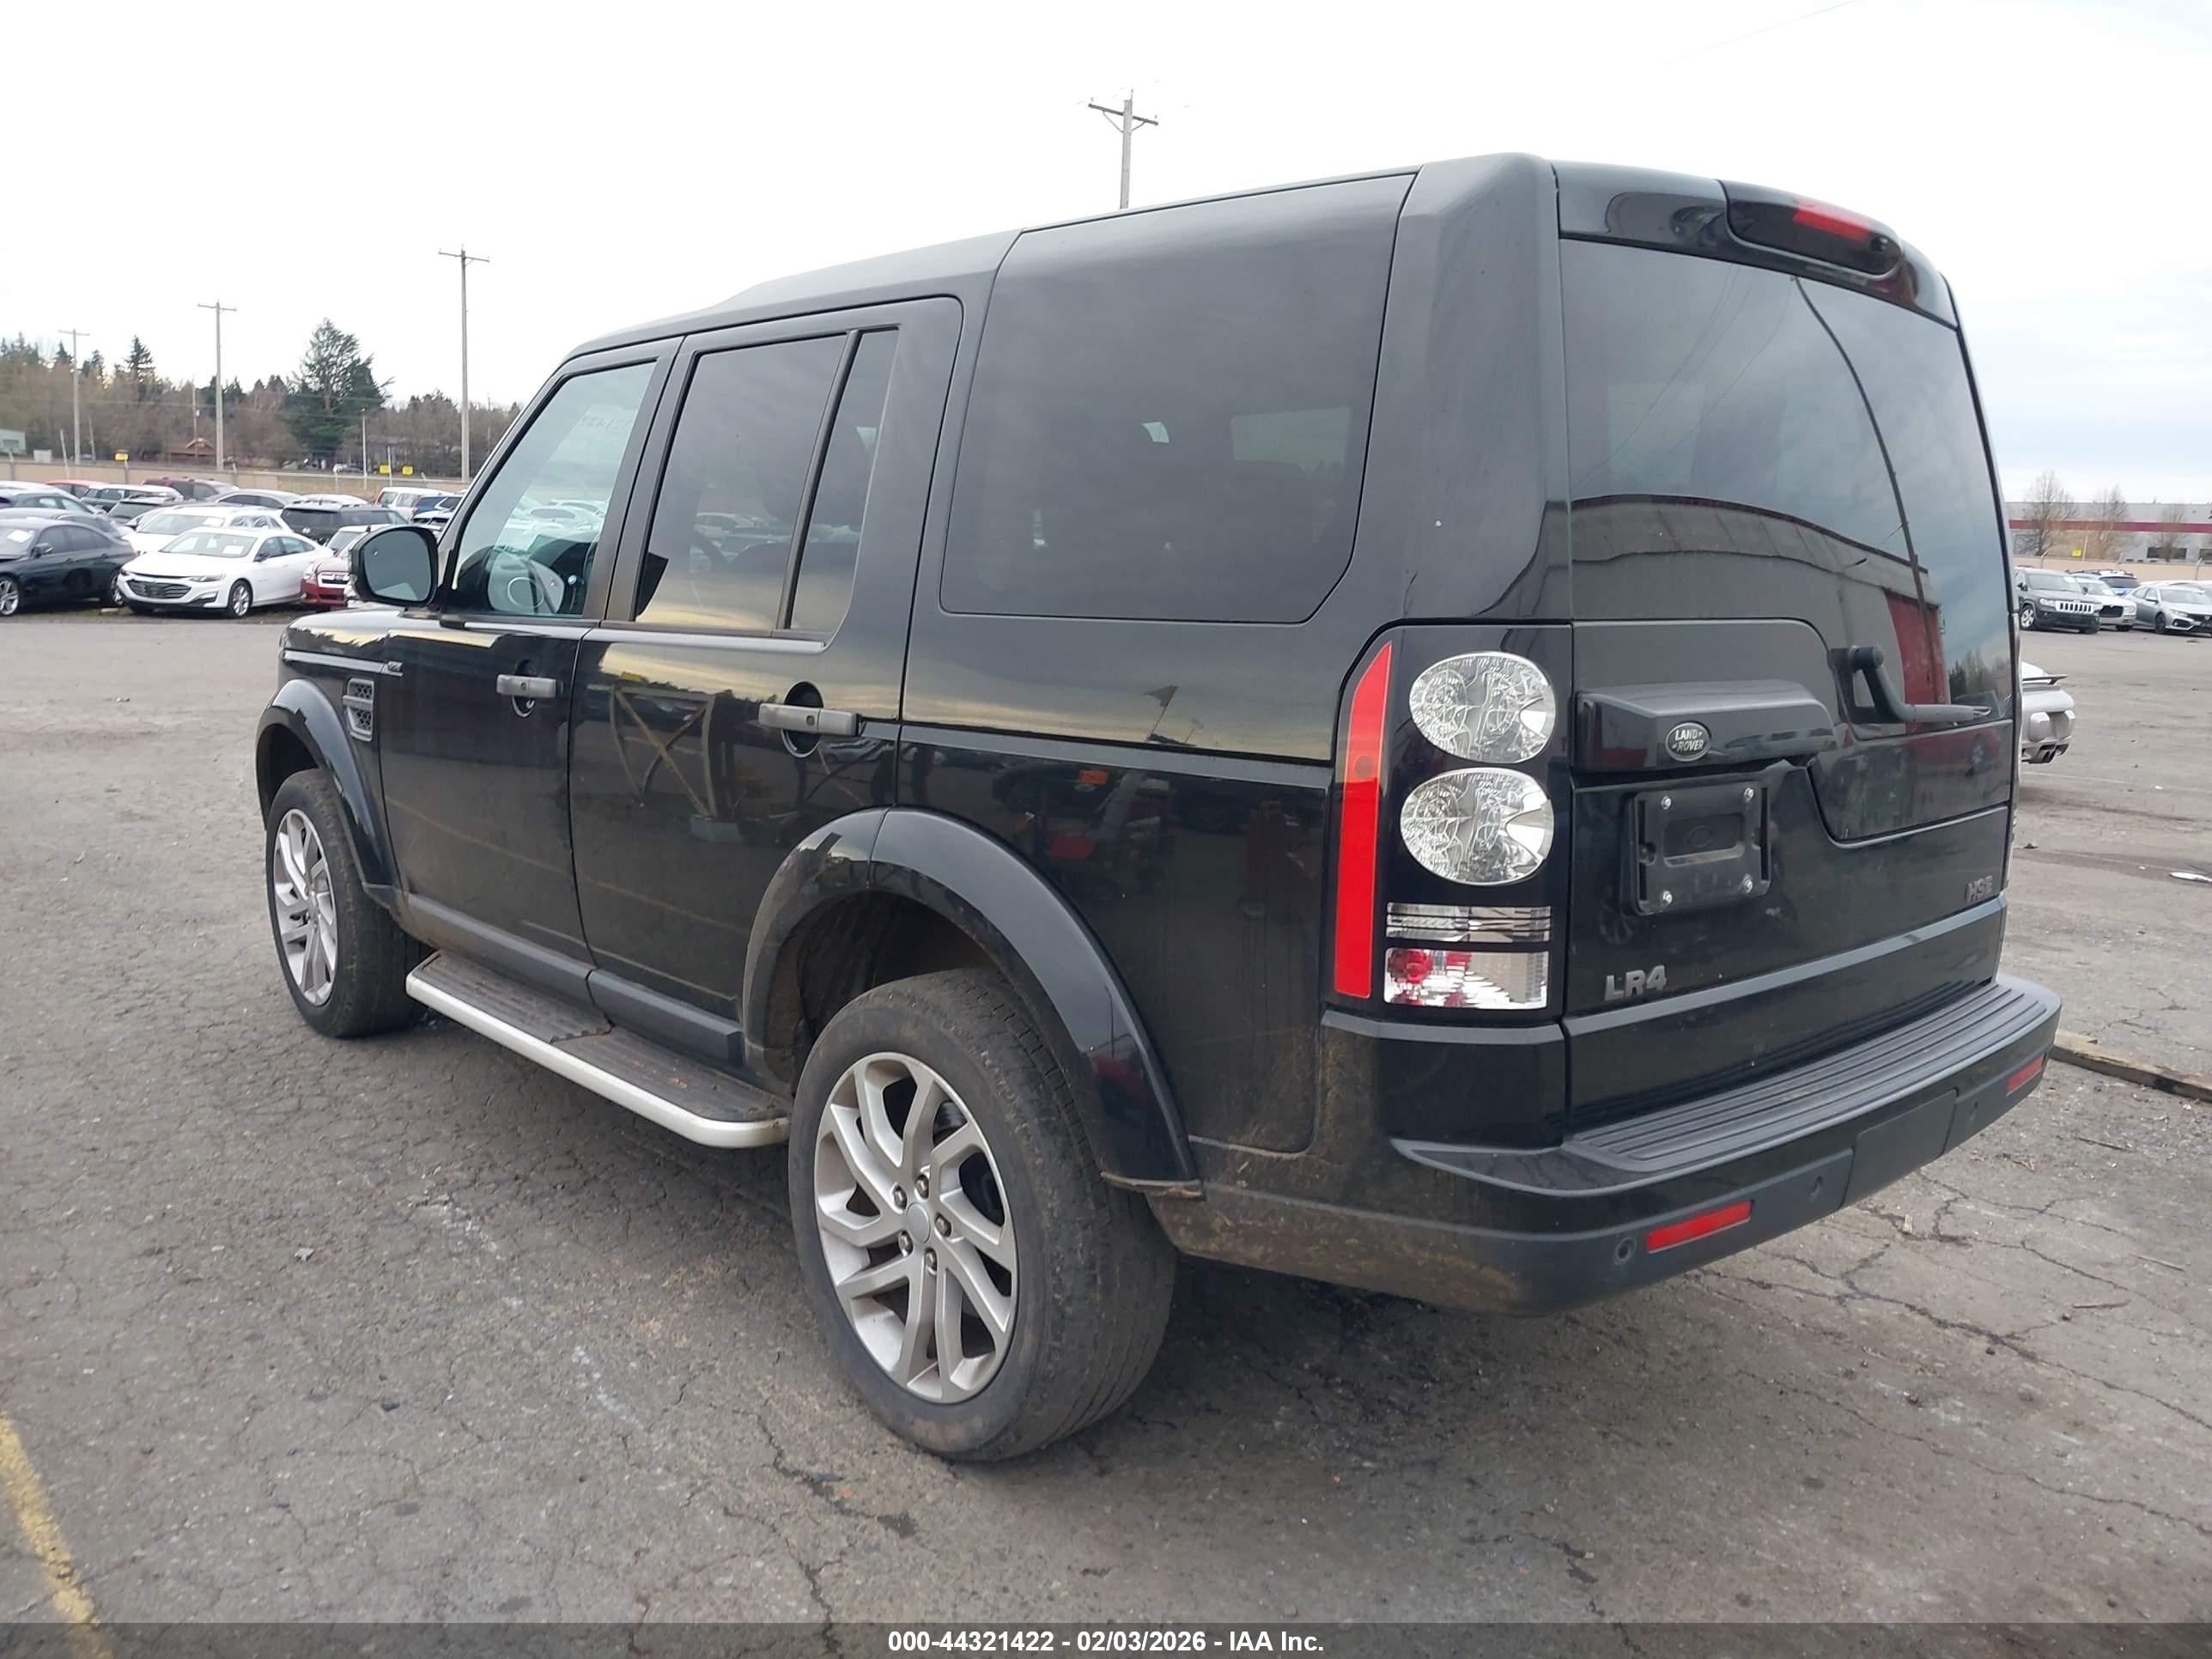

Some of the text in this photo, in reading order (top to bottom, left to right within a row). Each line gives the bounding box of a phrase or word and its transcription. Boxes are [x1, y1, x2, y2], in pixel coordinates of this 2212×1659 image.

[1675, 729, 1698, 740] LAND
[1677, 739, 1704, 751] ROVER
[1966, 876, 1993, 902] HSE
[1604, 964, 1667, 1001] LR4
